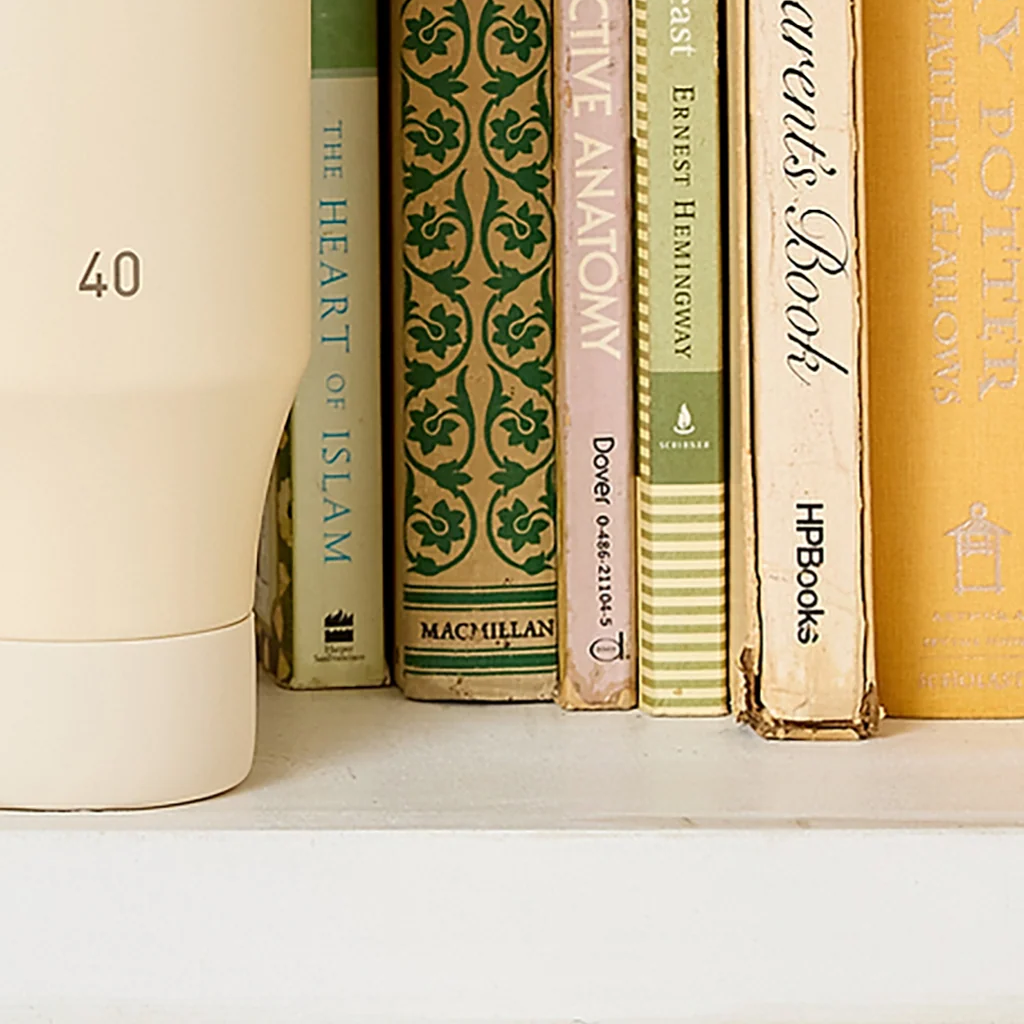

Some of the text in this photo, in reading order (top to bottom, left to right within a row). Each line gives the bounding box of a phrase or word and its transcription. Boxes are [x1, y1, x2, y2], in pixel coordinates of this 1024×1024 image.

[79, 251, 140, 298] 40
[573, 132, 621, 360] ANATOMY
[672, 85, 696, 360] ERNEST HEMINGWAY
[784, 204, 850, 386] Book
[928, 200, 962, 406] HALLOWS
[977, 98, 1022, 403] POTTER
[319, 120, 353, 564] THE HEART OF ISLAM
[592, 437, 615, 505] Dover
[420, 618, 555, 641] MACMILLAN
[796, 503, 825, 644] HPBooks
